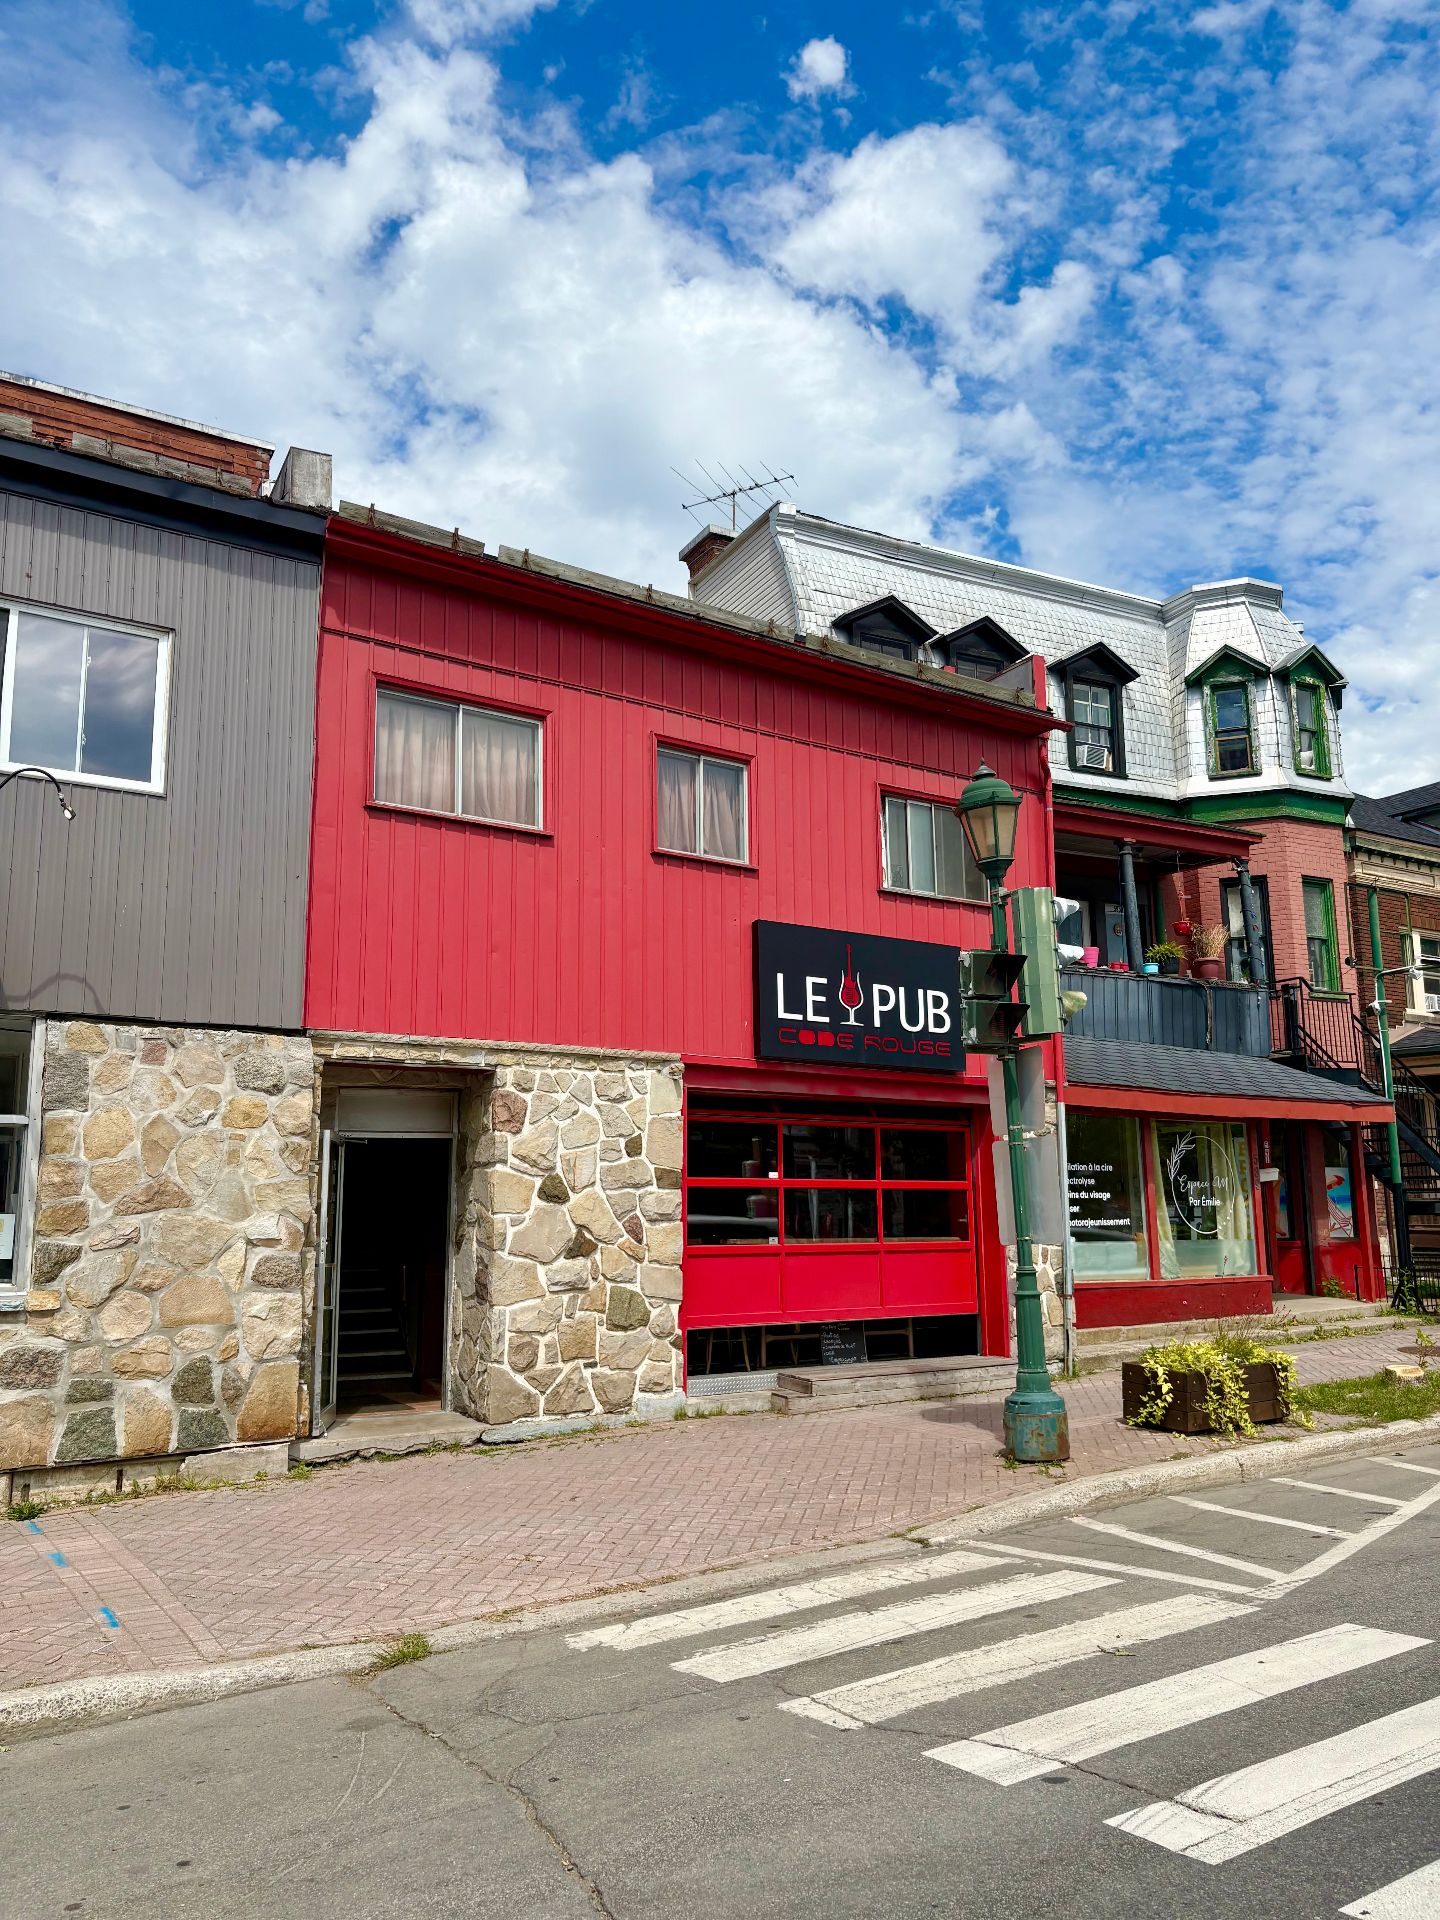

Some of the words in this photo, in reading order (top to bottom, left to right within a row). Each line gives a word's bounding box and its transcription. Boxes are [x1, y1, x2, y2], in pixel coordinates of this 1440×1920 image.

[776, 972, 830, 1023] LE
[872, 983, 951, 1034] PUB
[778, 1026, 855, 1049] CODE
[863, 1035, 951, 1057] ROUGE
[1088, 1162, 1093, 1171] à
[1093, 1163, 1100, 1171] la
[1101, 1163, 1113, 1171] cire
[1177, 1174, 1210, 1195] Espace
[1080, 1190, 1089, 1199] du
[1090, 1190, 1111, 1201] visage
[1189, 1196, 1200, 1206] Par
[1201, 1194, 1221, 1207] Émilie
